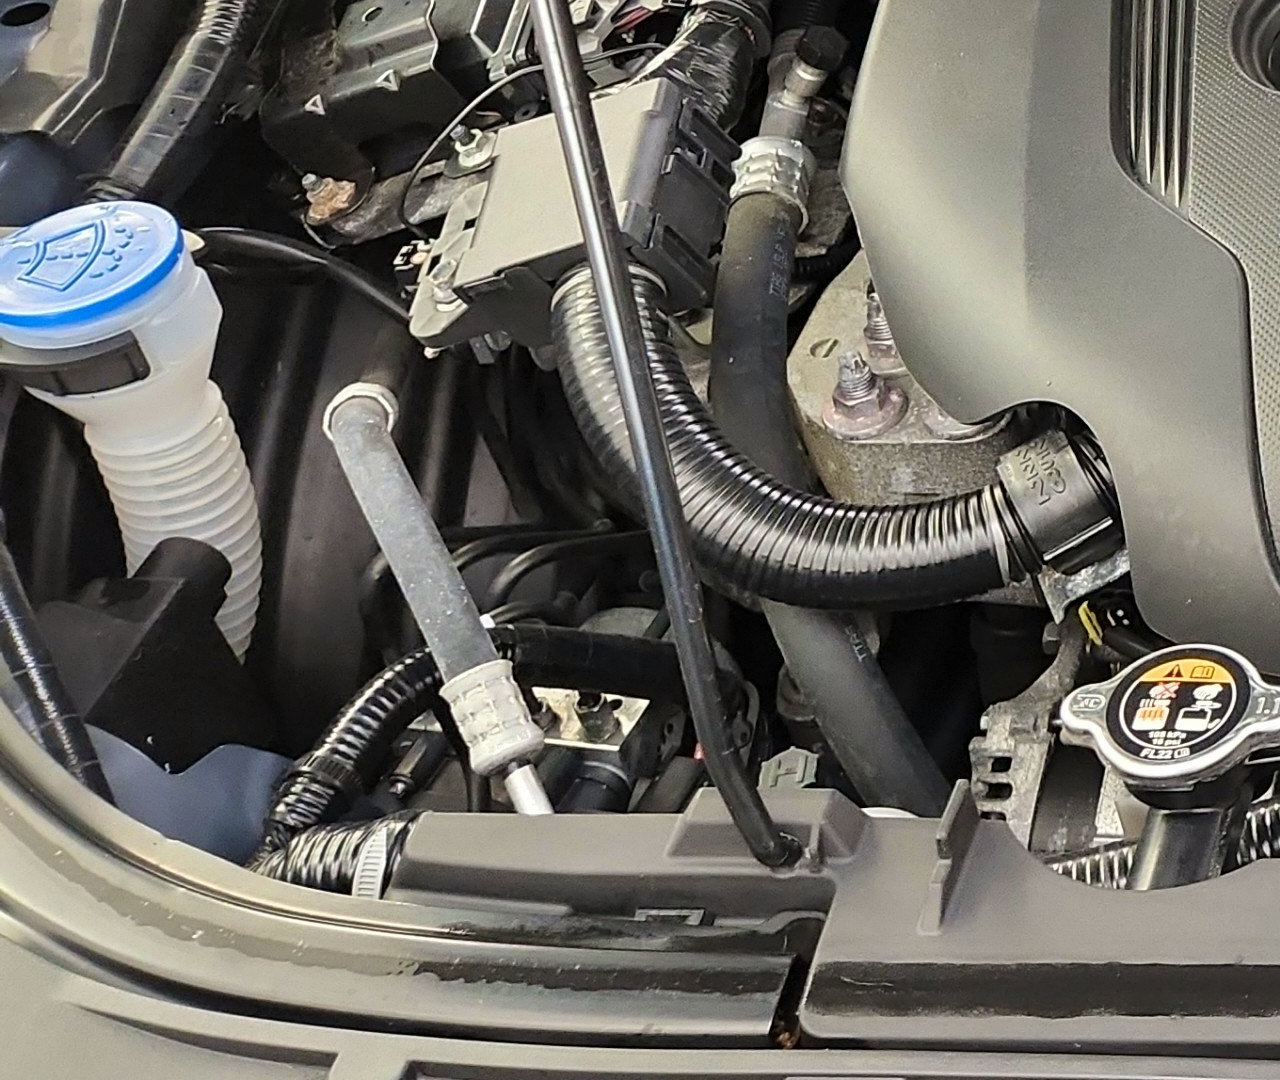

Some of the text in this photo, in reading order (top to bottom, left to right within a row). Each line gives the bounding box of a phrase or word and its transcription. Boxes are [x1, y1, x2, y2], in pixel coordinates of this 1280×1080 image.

[1167, 730, 1187, 739] kPa
[1164, 738, 1182, 747] psi
[1139, 748, 1174, 760] FL22
